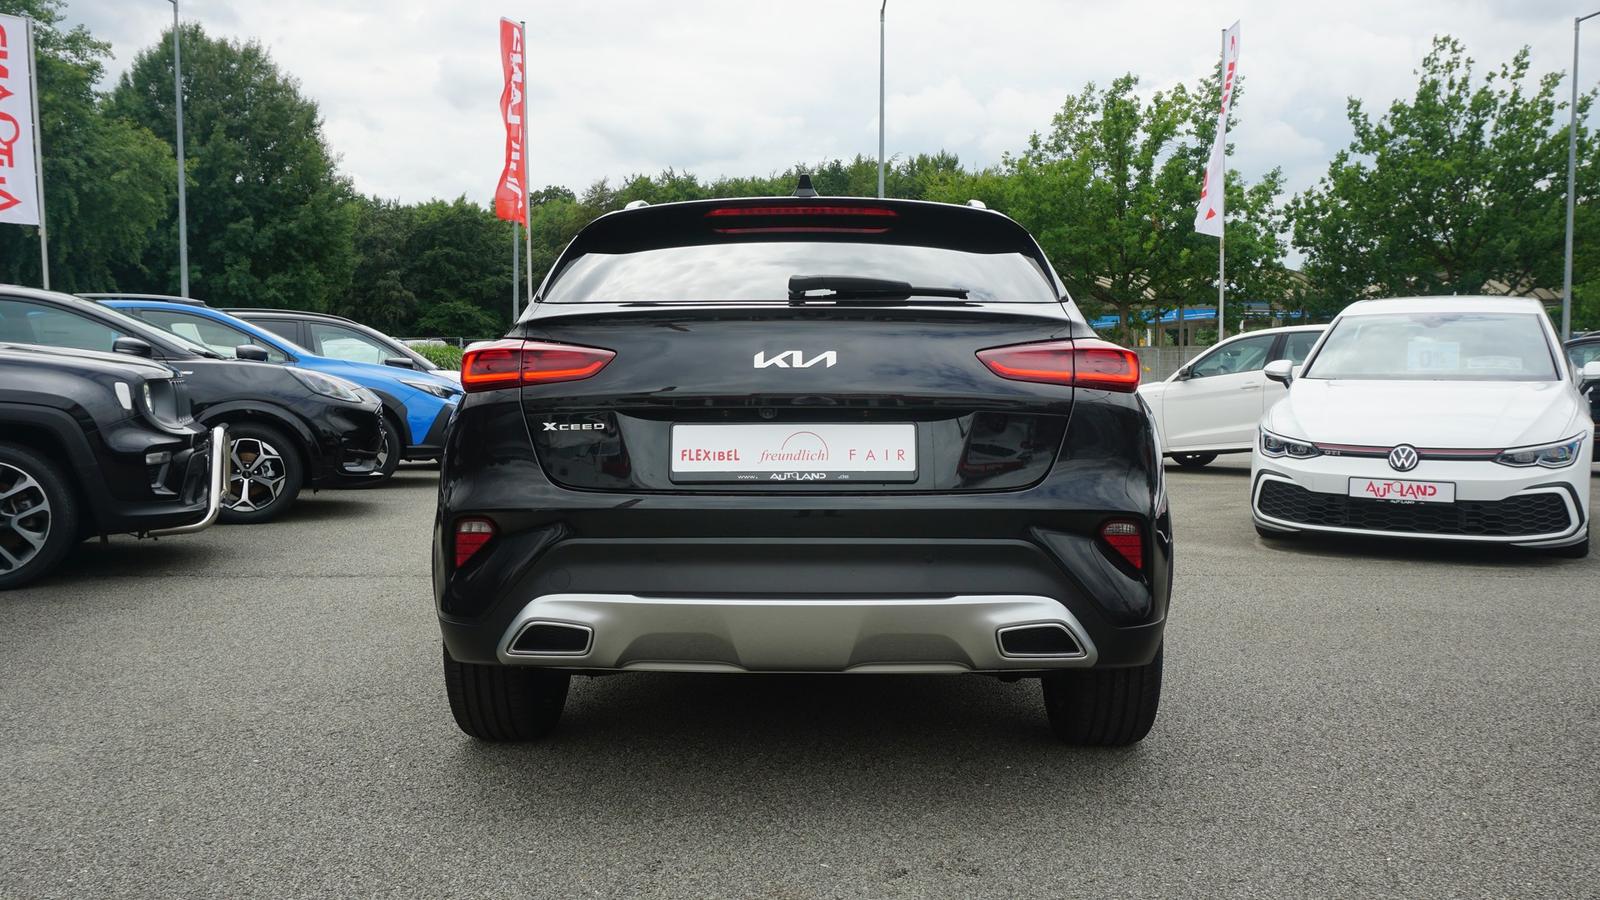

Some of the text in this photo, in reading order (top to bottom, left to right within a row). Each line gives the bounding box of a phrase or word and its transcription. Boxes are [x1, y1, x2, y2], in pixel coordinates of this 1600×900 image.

[754, 351, 836, 368] KIA
[681, 448, 905, 464] FLEXIBEL freundlich FAIR
[770, 472, 827, 480] AUTOLAND
[1366, 480, 1438, 499] AUTOLAND
